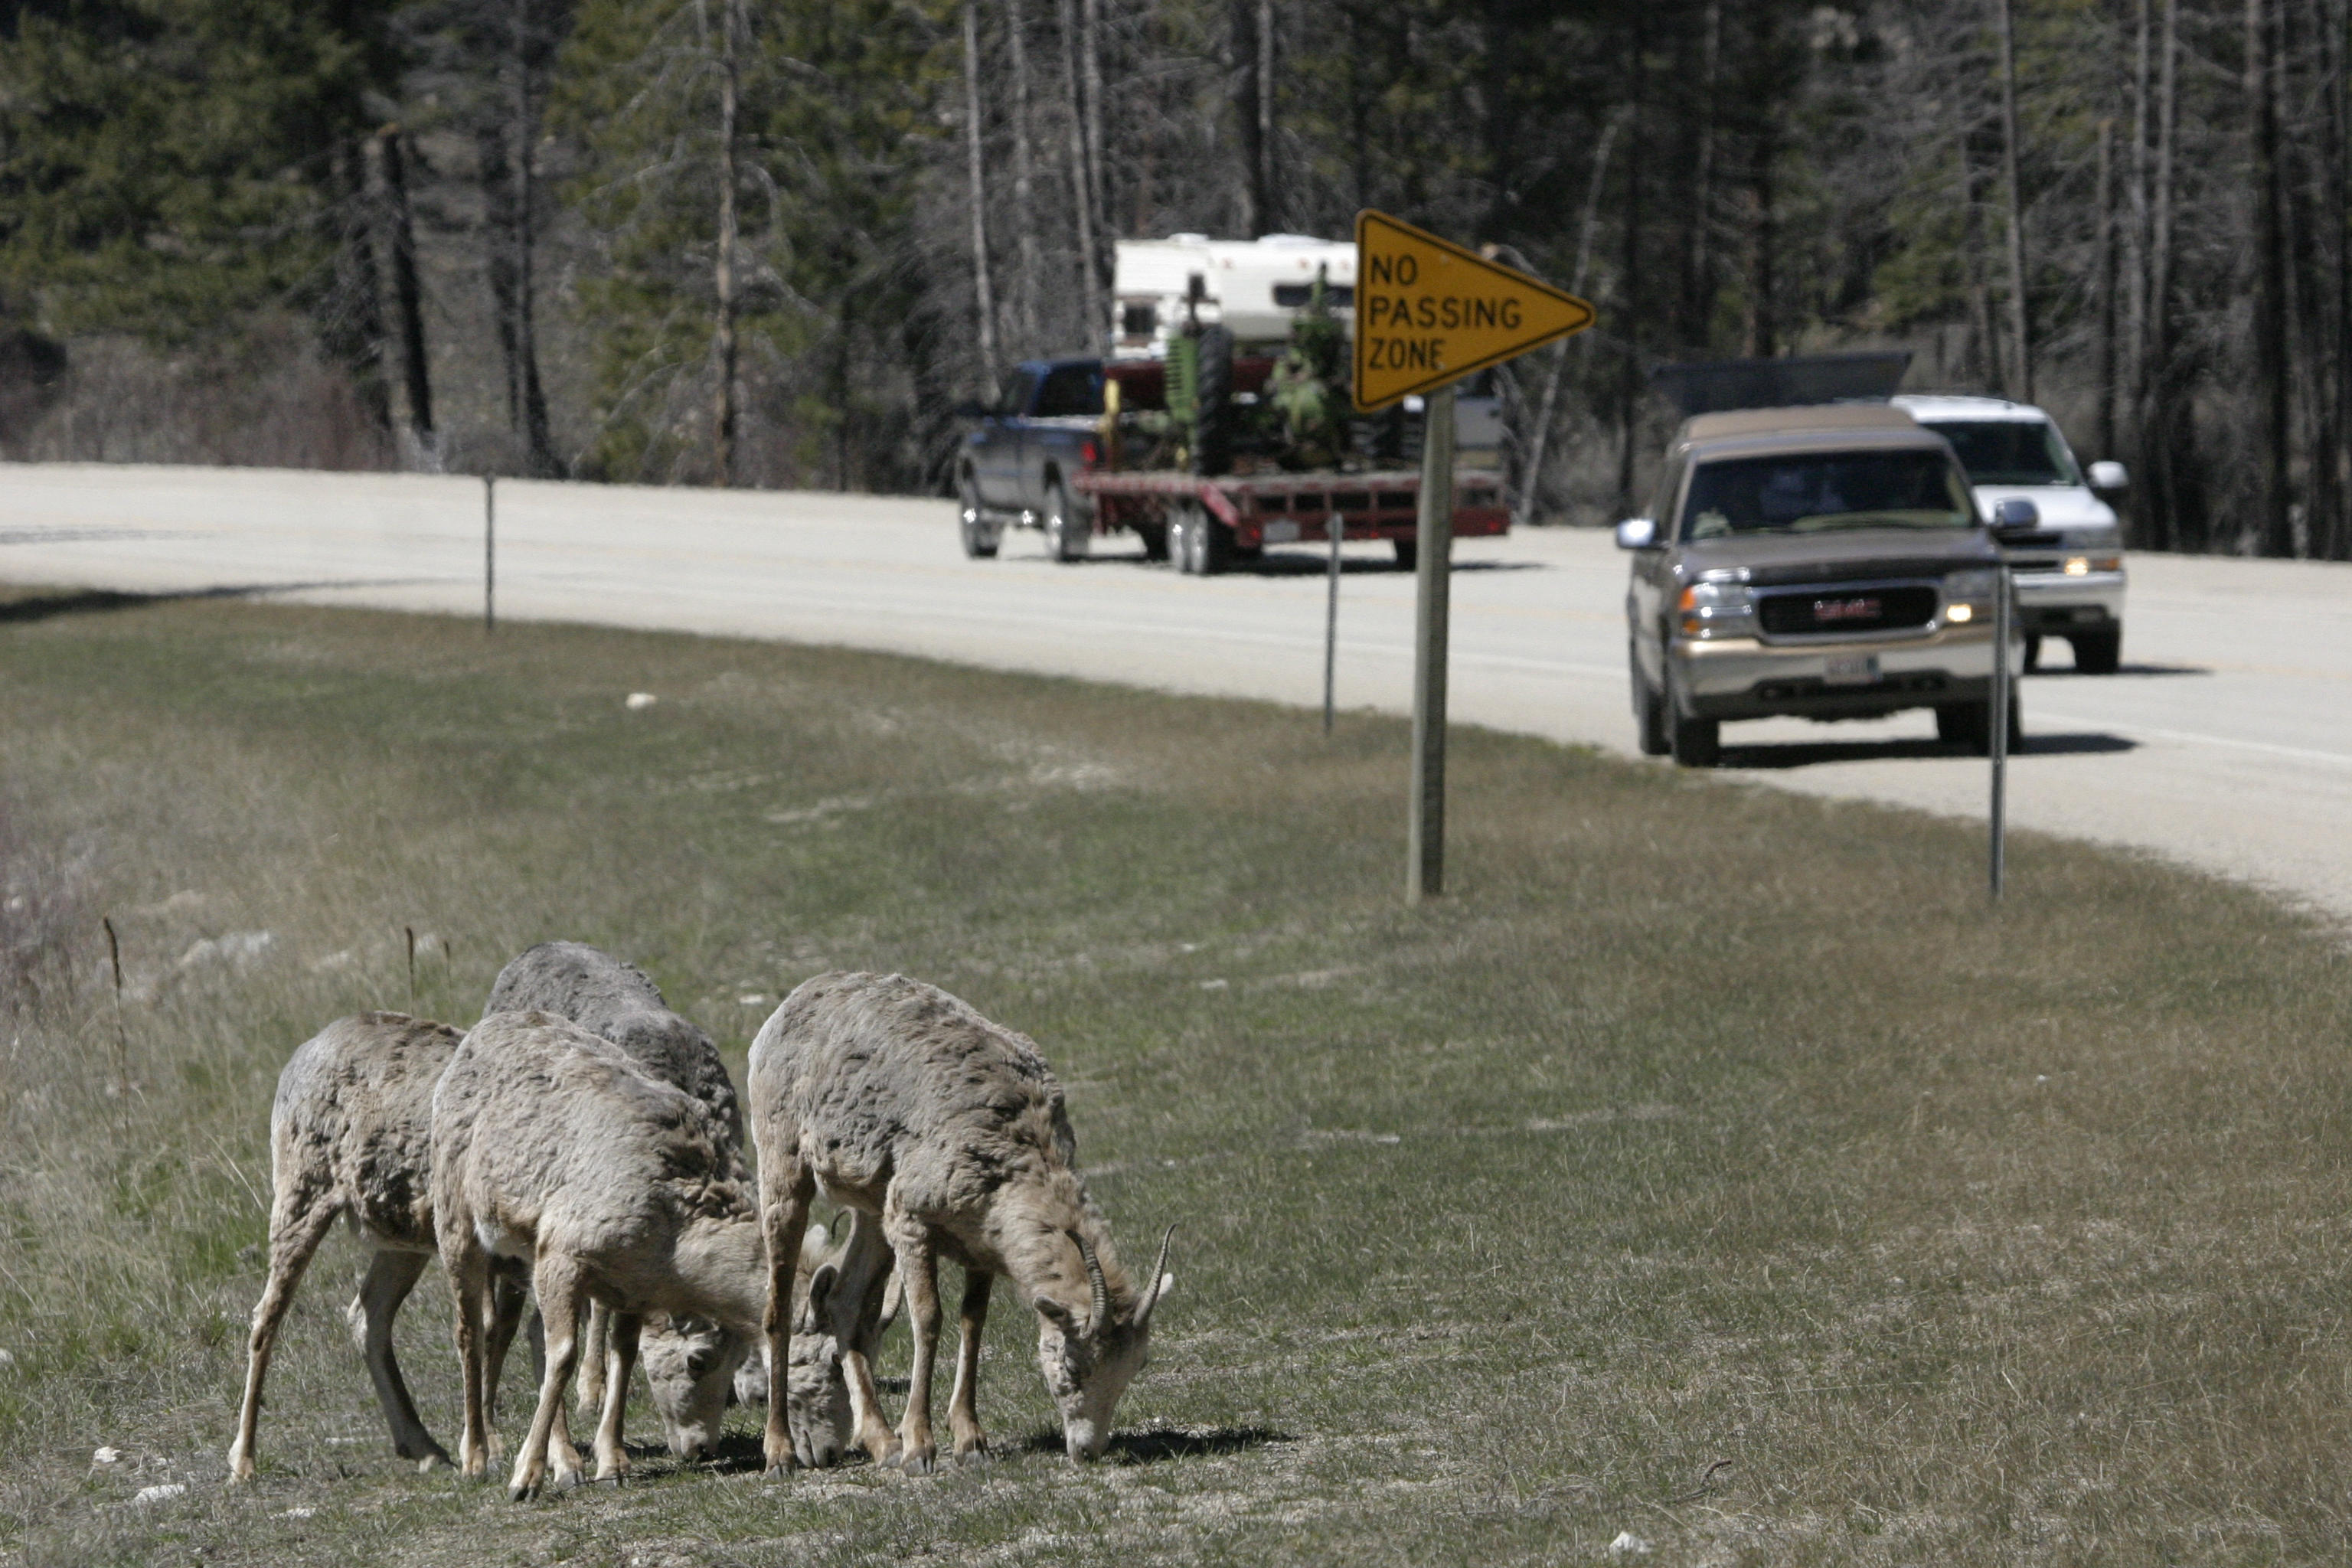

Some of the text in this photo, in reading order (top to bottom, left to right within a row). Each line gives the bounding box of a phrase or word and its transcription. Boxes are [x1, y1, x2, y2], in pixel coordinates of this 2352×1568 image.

[1370, 255, 1418, 285] NO
[1369, 296, 1521, 328] PASSING
[1368, 338, 1446, 371] ZONE
